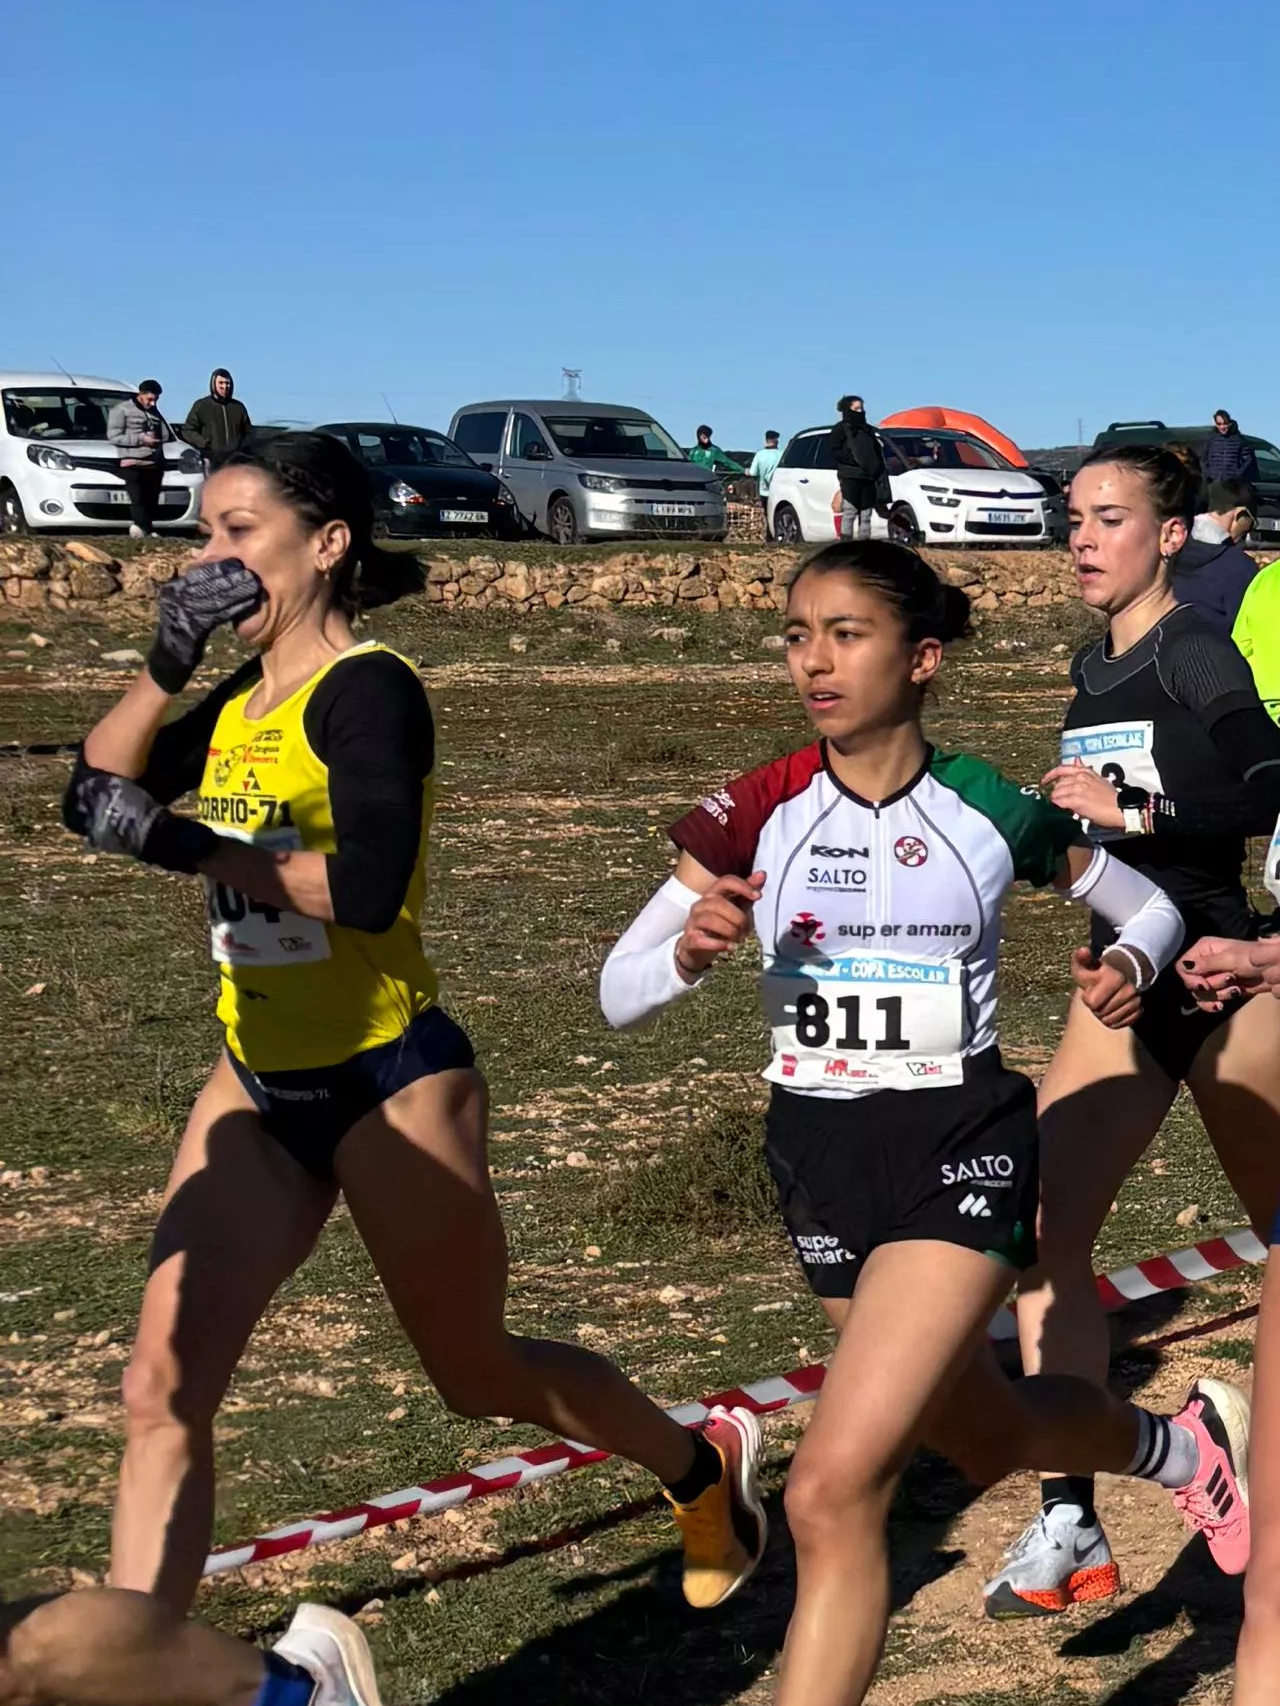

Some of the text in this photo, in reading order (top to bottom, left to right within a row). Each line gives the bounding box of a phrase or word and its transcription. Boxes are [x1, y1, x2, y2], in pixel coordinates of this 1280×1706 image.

[197, 796, 295, 827] ORPIO-71
[808, 867, 867, 885] SALTO
[906, 921, 972, 938] amara
[851, 959, 887, 979] COPA
[888, 963, 946, 983] ESCOLAR
[795, 992, 911, 1051] 811
[940, 1154, 1014, 1186] SALTO
[796, 1234, 839, 1252] supe
